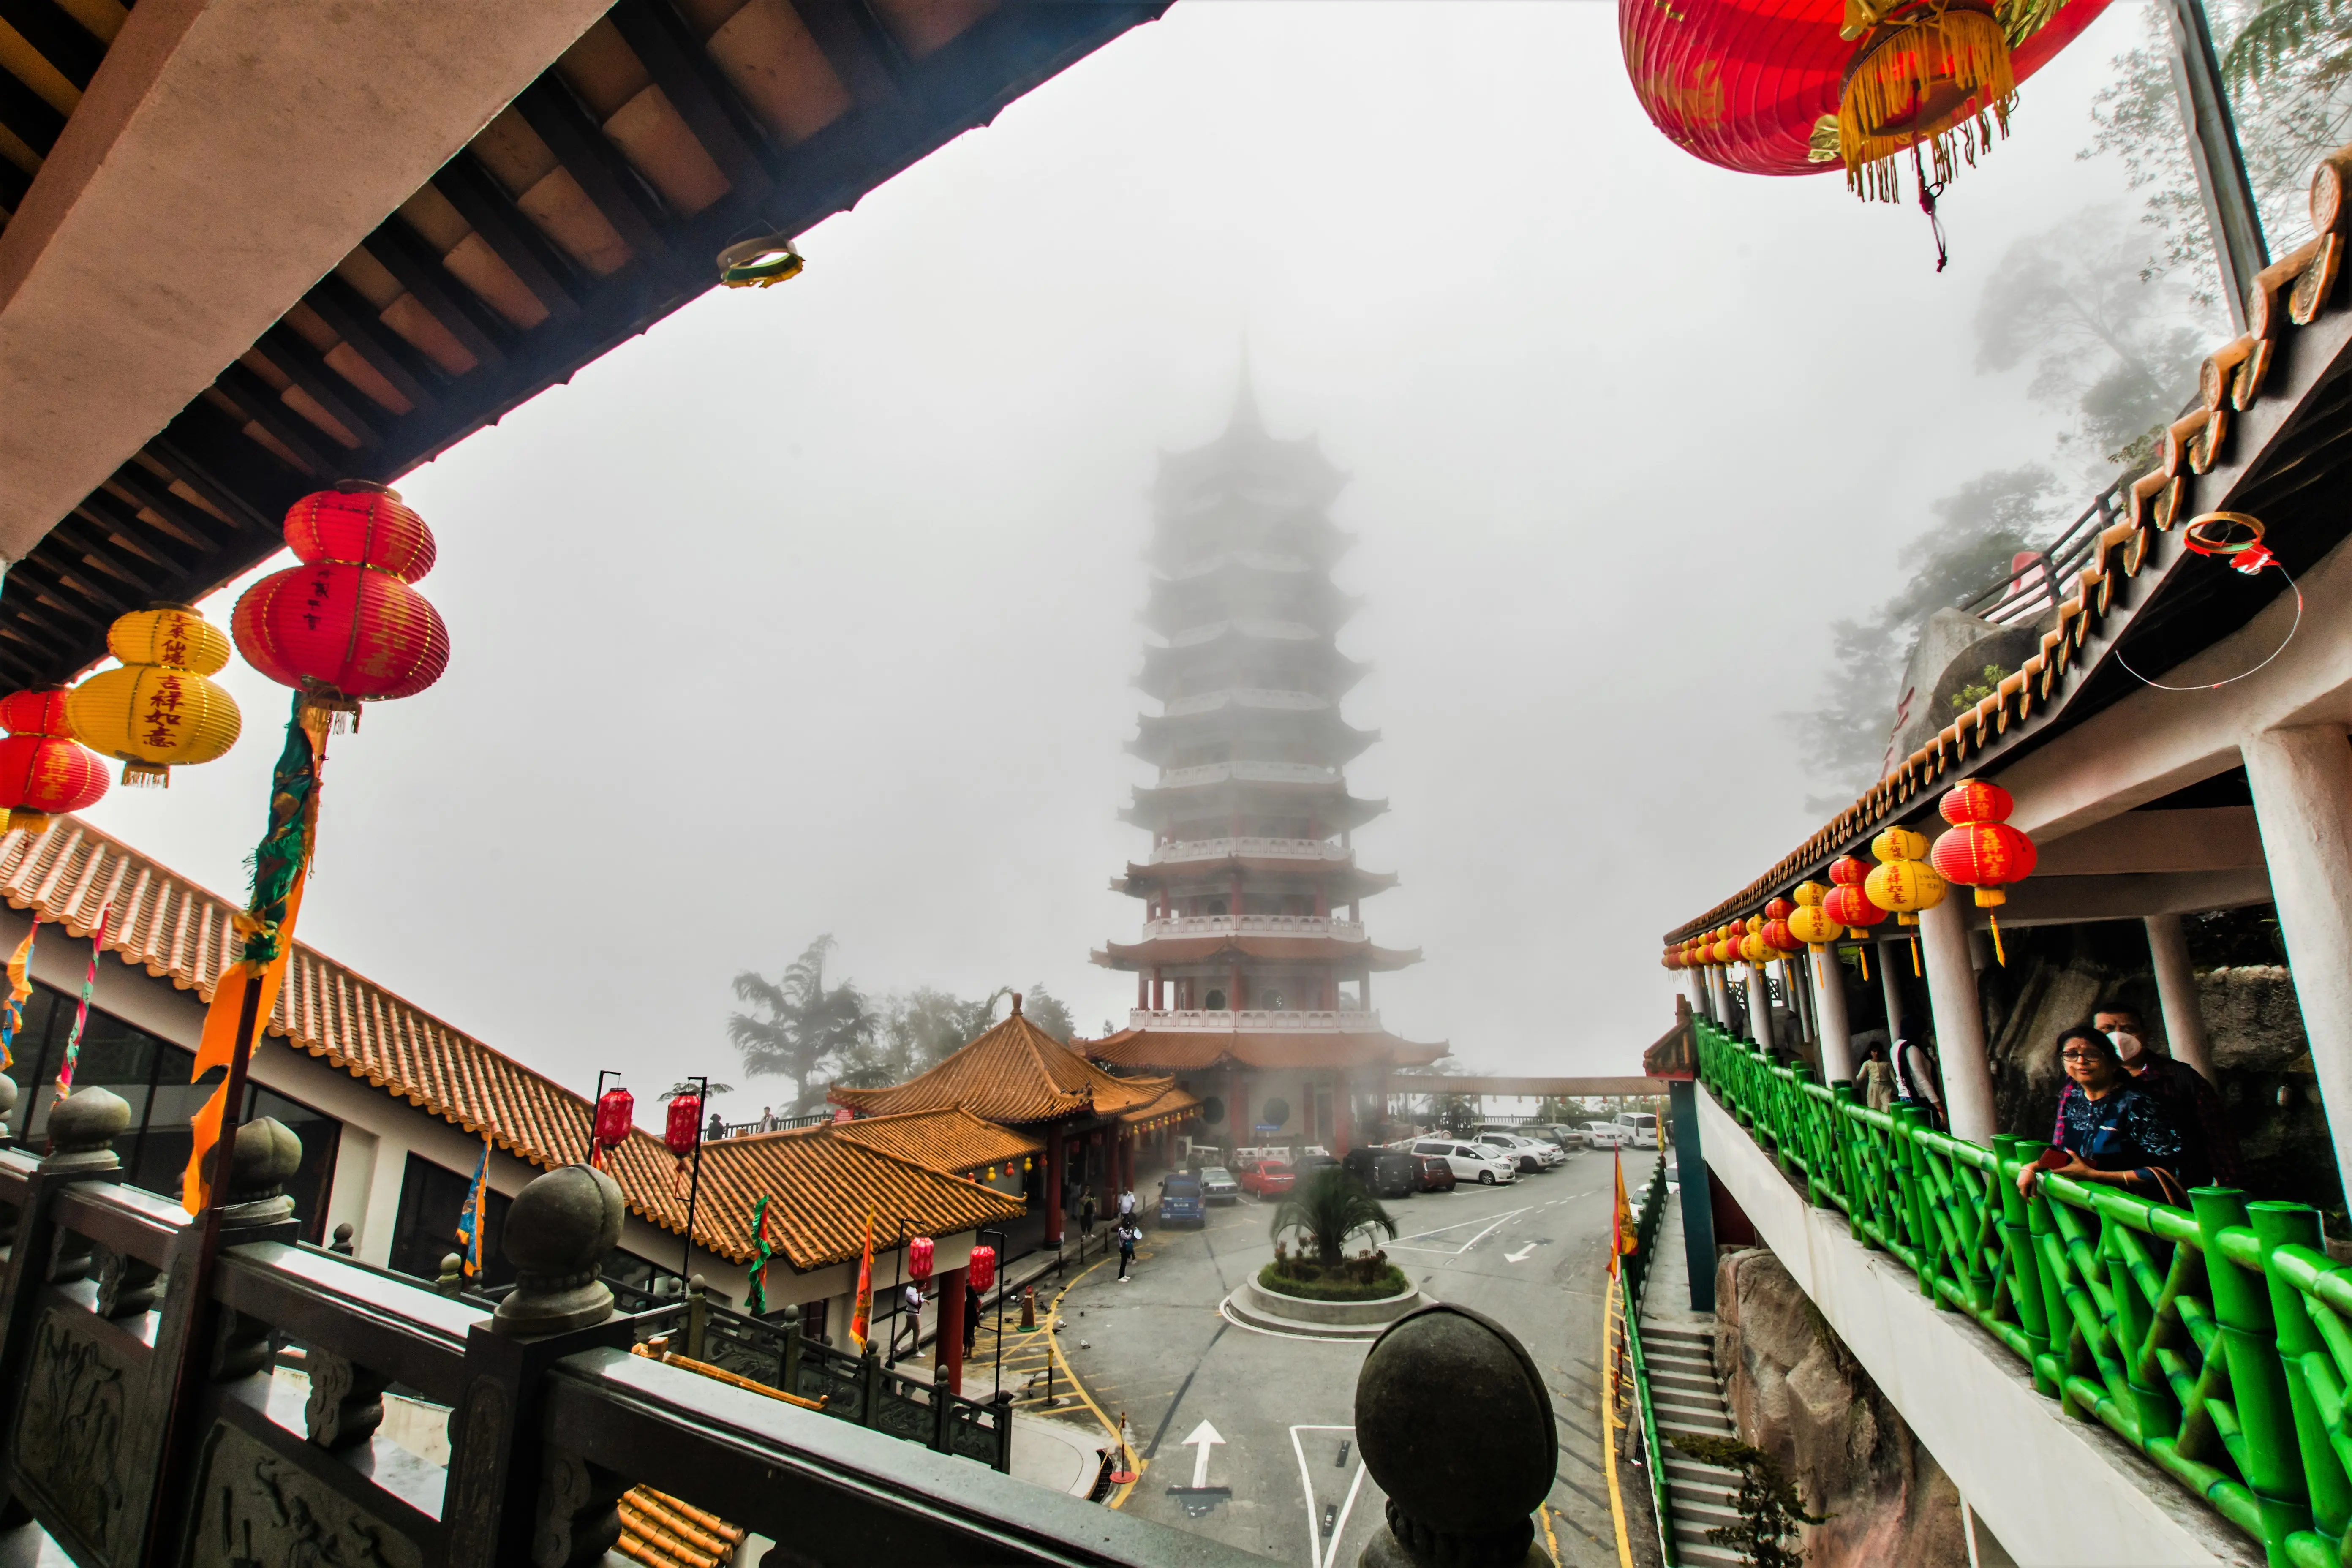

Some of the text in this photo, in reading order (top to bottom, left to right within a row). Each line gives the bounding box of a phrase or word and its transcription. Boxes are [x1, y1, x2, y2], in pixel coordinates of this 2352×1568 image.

[142, 674, 187, 748] 吉祥如意
[1886, 865, 1907, 904] 吉祥如意
